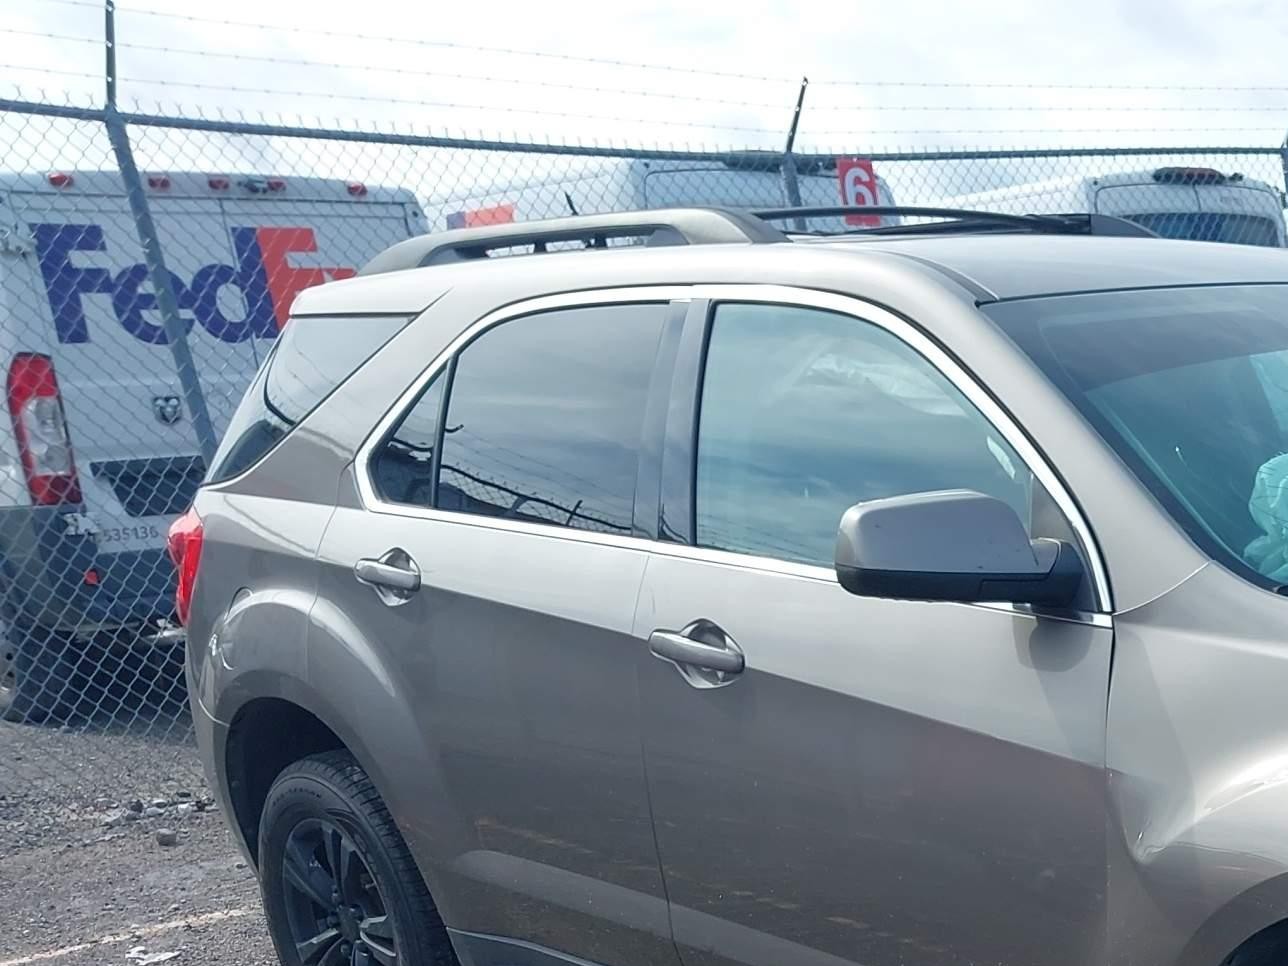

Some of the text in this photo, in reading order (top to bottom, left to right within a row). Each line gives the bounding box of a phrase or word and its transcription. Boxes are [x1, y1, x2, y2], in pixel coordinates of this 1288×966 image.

[845, 167, 874, 208] 6
[29, 223, 356, 345] FedE
[103, 526, 159, 542] 535136
